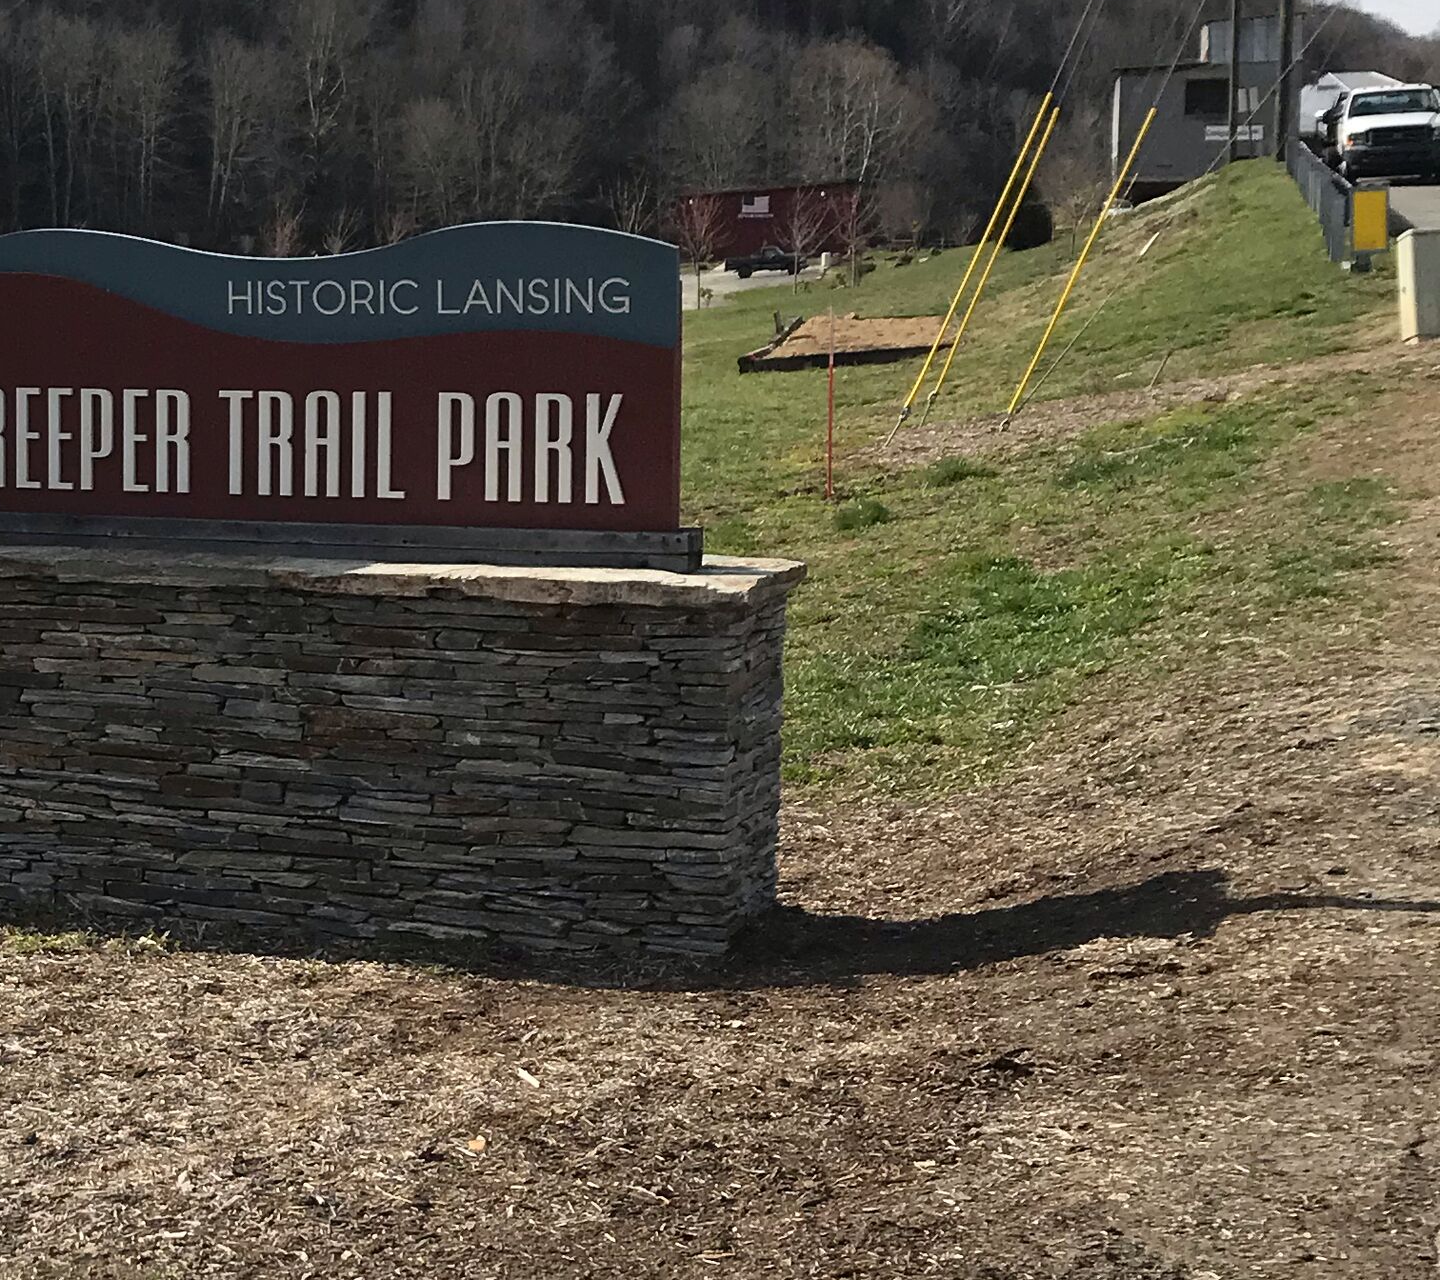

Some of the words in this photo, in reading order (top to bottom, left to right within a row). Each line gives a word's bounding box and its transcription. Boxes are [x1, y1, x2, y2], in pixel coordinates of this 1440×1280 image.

[227, 279, 419, 316] HISTORIC
[437, 277, 631, 316] LANSING
[218, 390, 406, 499] TRAIL
[437, 392, 626, 505] PARK
